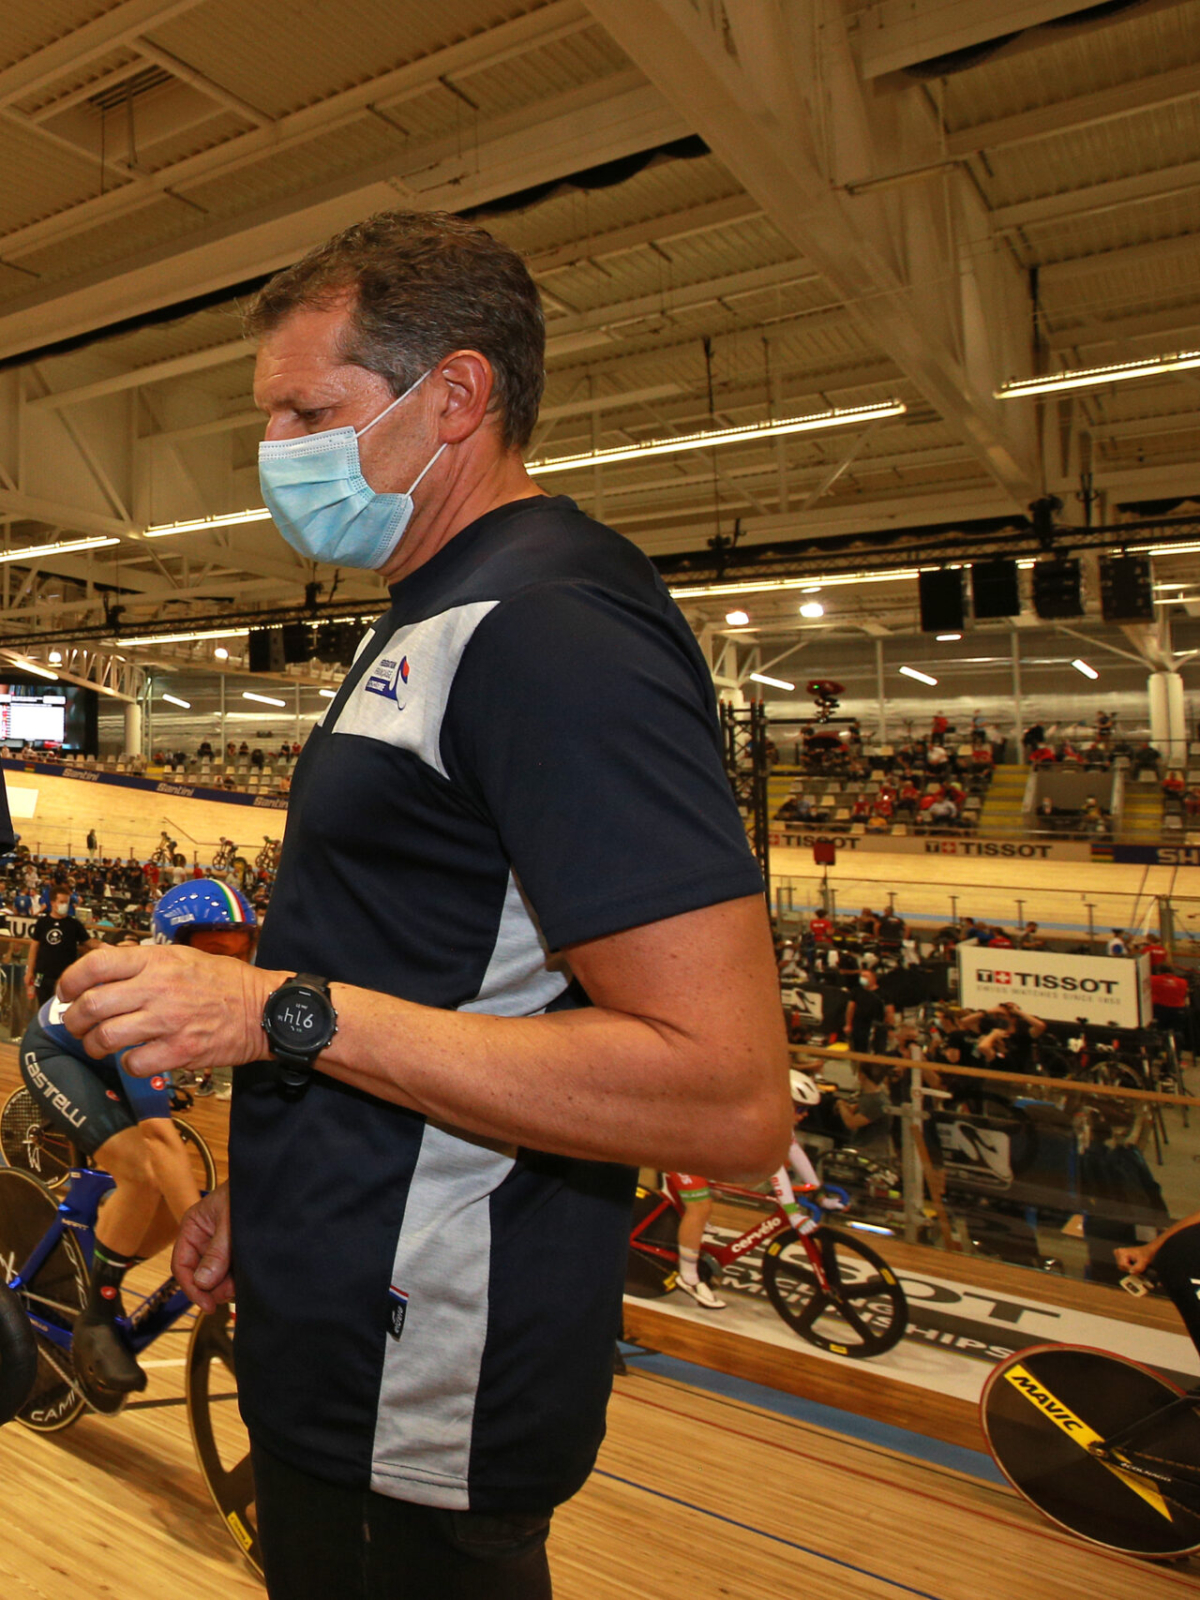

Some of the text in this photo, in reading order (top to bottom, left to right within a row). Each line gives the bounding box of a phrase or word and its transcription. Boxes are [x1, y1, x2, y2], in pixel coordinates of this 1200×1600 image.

[62, 767, 101, 783] Santini
[156, 781, 196, 798] Santini
[253, 796, 289, 810] Santin
[959, 842, 1052, 860] TISSOT
[1014, 972, 1119, 995] TISSOT
[730, 1216, 782, 1254] cervélo
[1012, 1375, 1084, 1432] MAVIC
